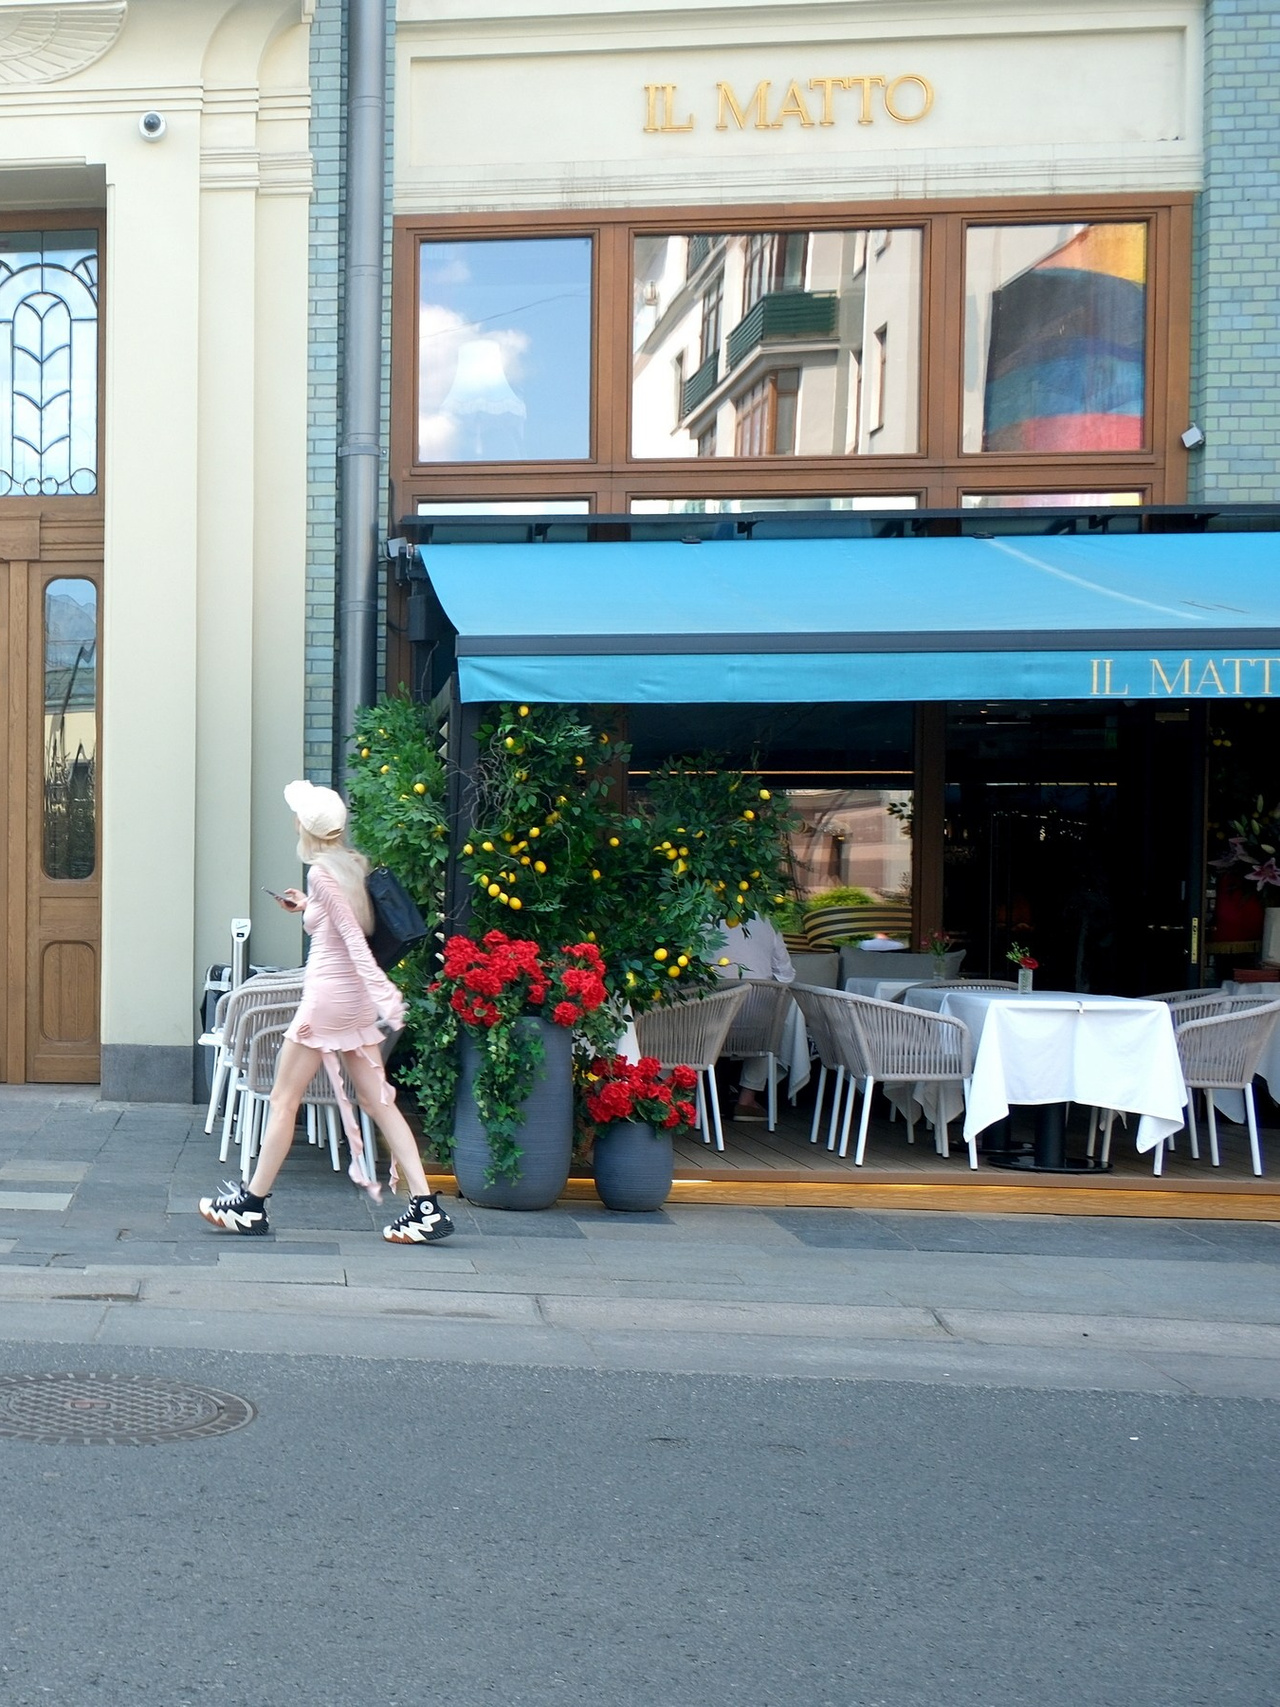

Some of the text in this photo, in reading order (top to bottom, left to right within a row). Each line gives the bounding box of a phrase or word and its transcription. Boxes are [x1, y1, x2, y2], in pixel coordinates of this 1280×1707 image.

[643, 73, 935, 132] IL MATTO
[1090, 659, 1128, 696] IL
